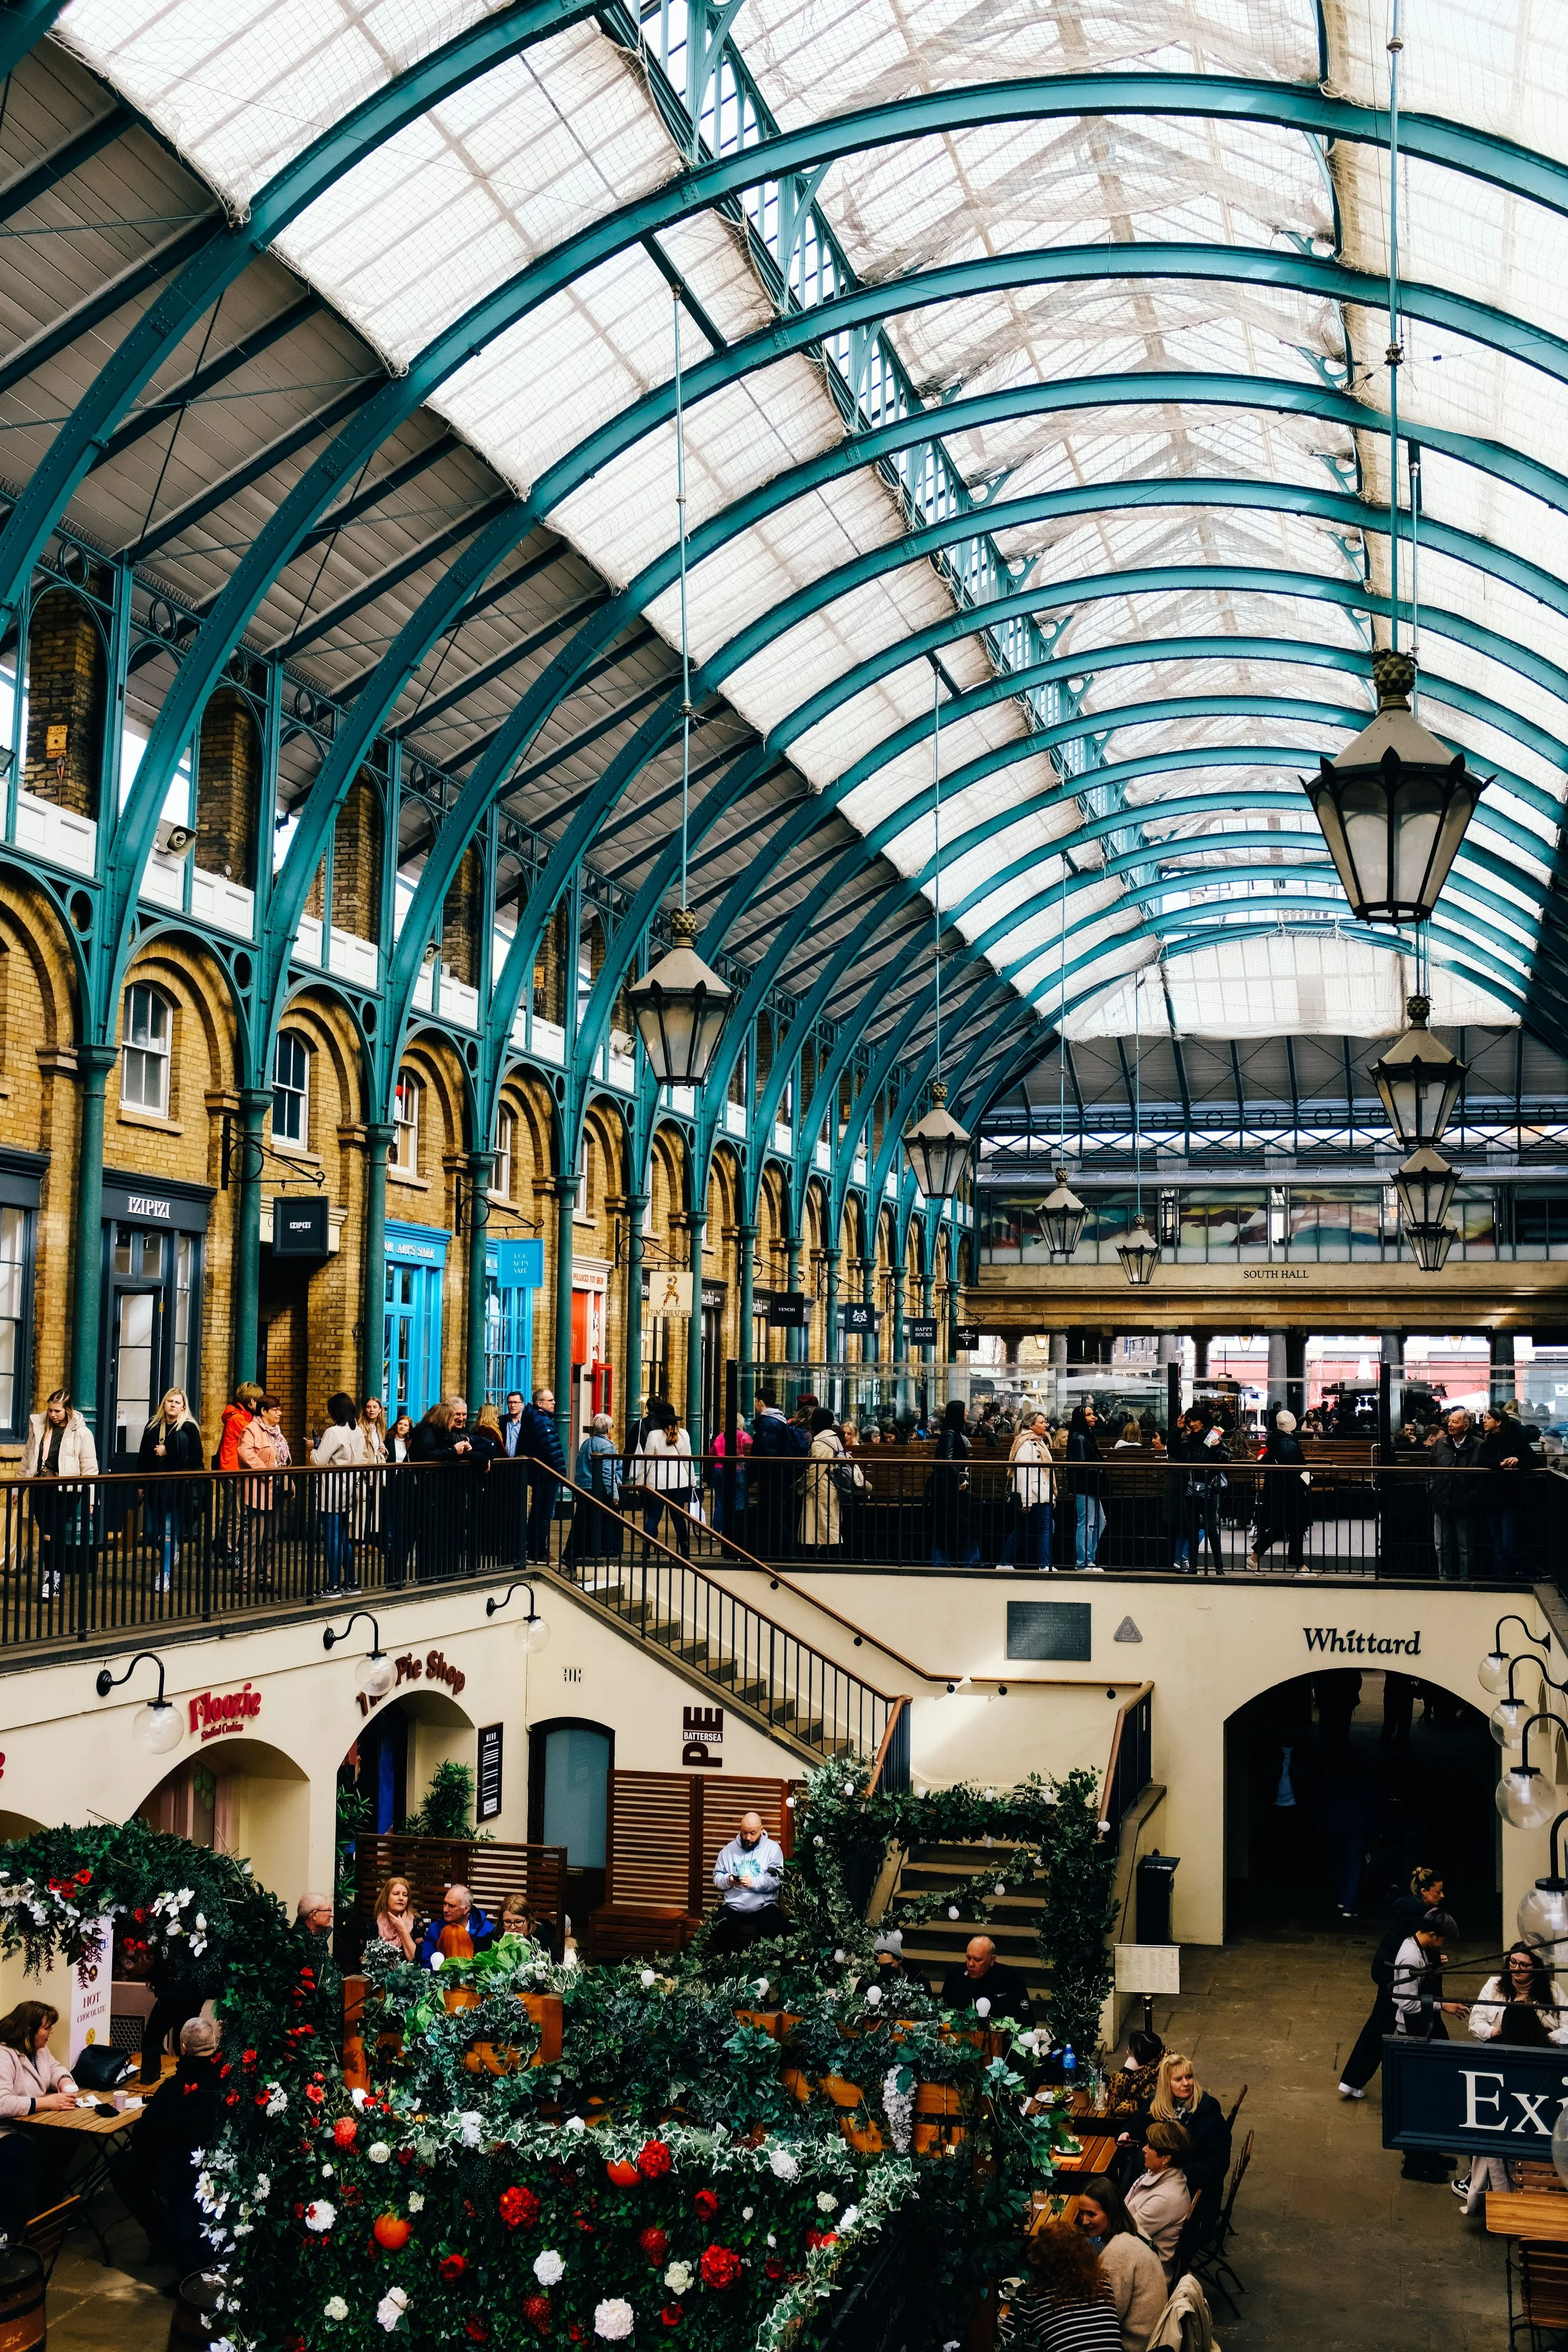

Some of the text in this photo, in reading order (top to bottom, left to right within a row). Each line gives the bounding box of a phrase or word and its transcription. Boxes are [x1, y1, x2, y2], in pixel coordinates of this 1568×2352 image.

[127, 1196, 171, 1219] IZIPIZI
[1244, 1270, 1309, 1278] SOUTH HALL
[1303, 1628, 1421, 1655] Whittard
[395, 1650, 465, 1695] Pie Shop
[189, 1682, 262, 1734] Floozie
[486, 1732, 497, 1742] MENU
[684, 1732, 722, 1742] BATTERSEA
[83, 1991, 101, 2008] HOT
[77, 2004, 106, 2023] CHOCOLATE
